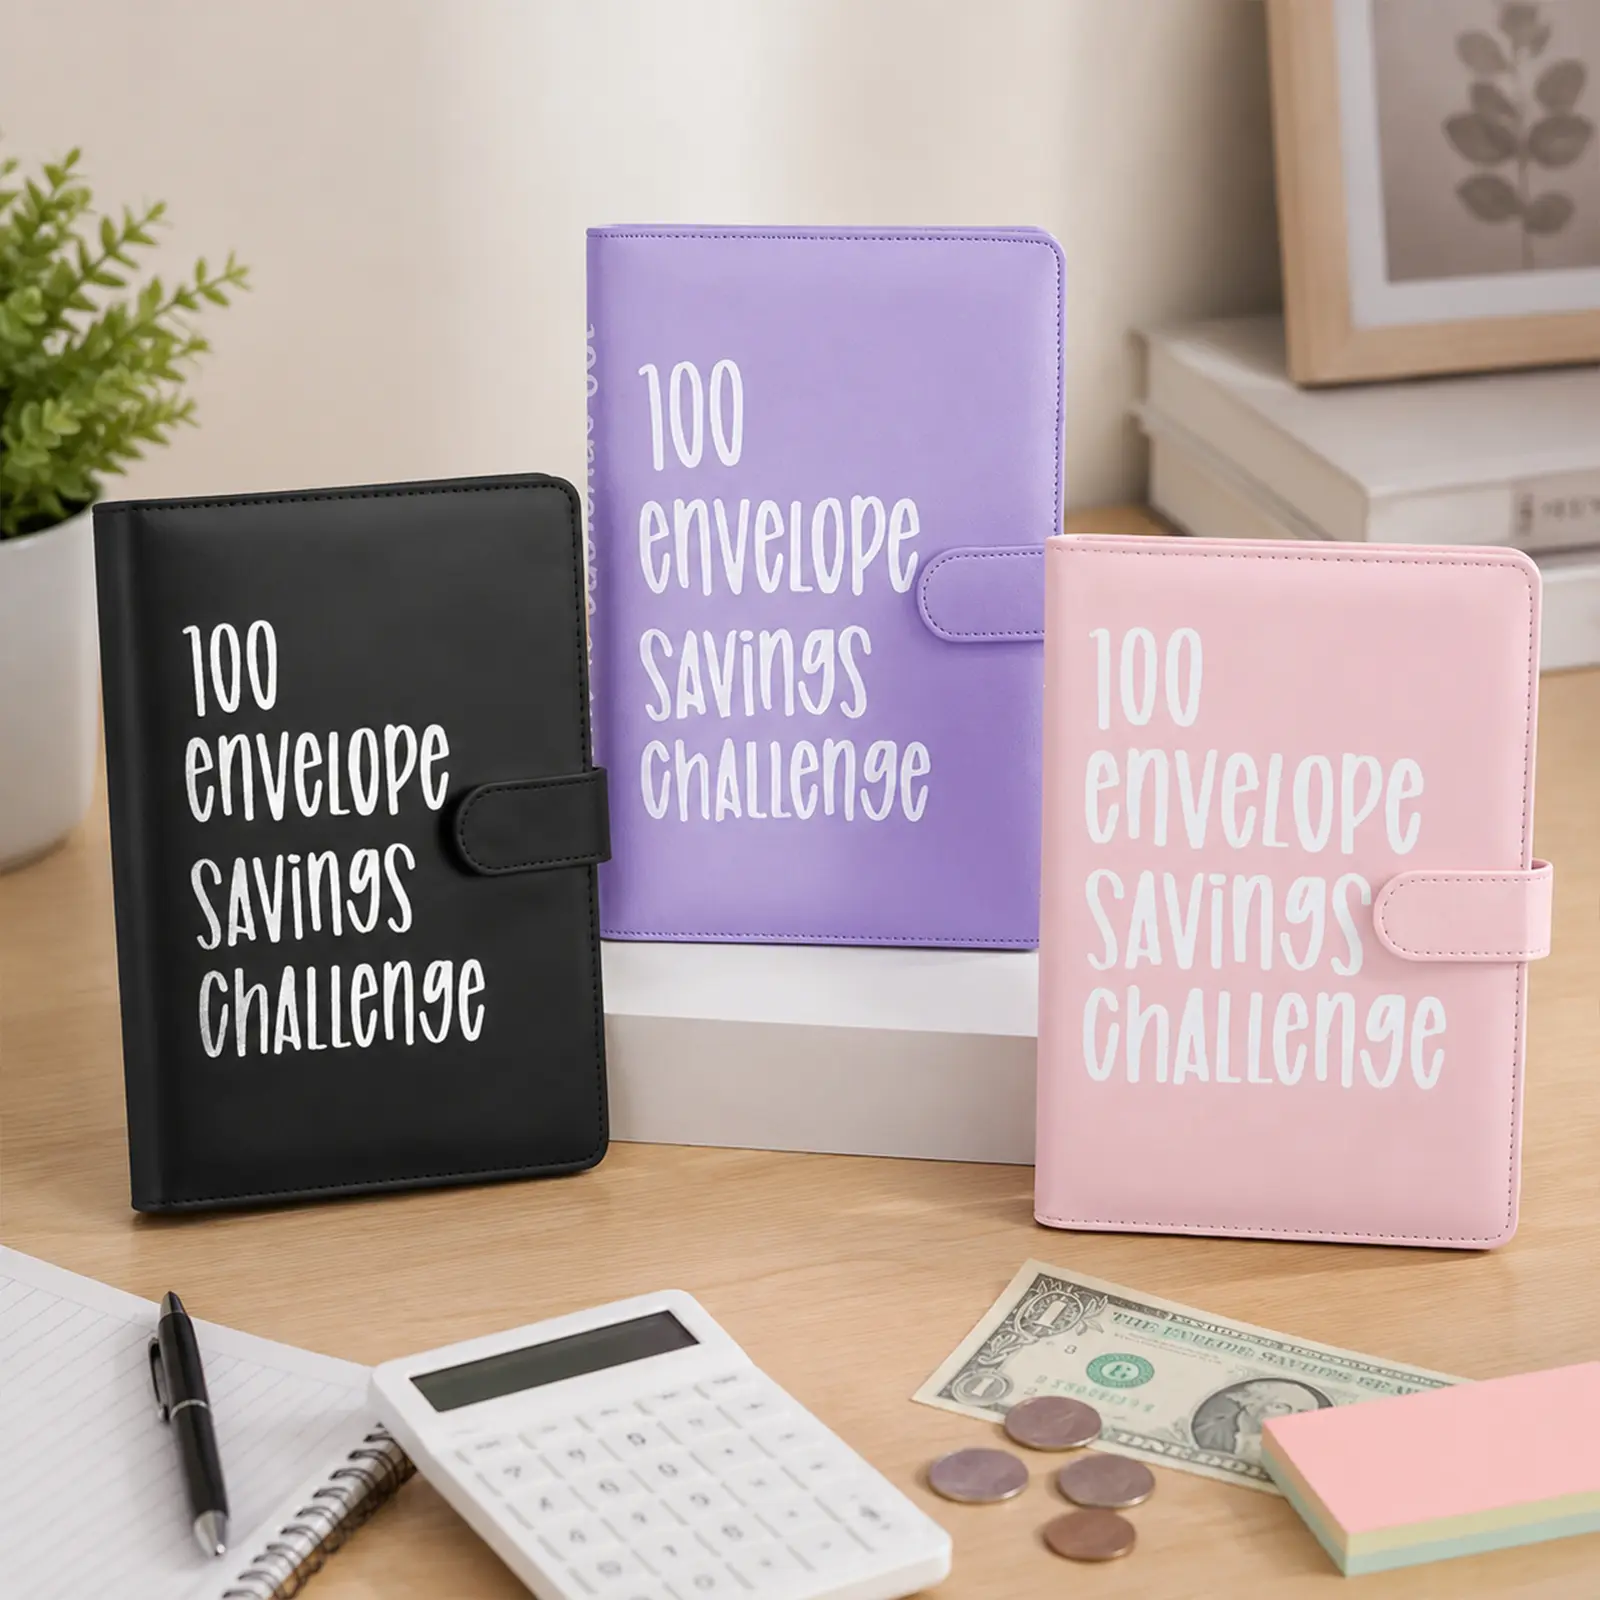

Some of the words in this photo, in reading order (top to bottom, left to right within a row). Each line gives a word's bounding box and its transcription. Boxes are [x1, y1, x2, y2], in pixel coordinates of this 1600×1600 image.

[638, 359, 744, 472] 100
[182, 619, 278, 718] 100
[1089, 627, 1203, 730] 100
